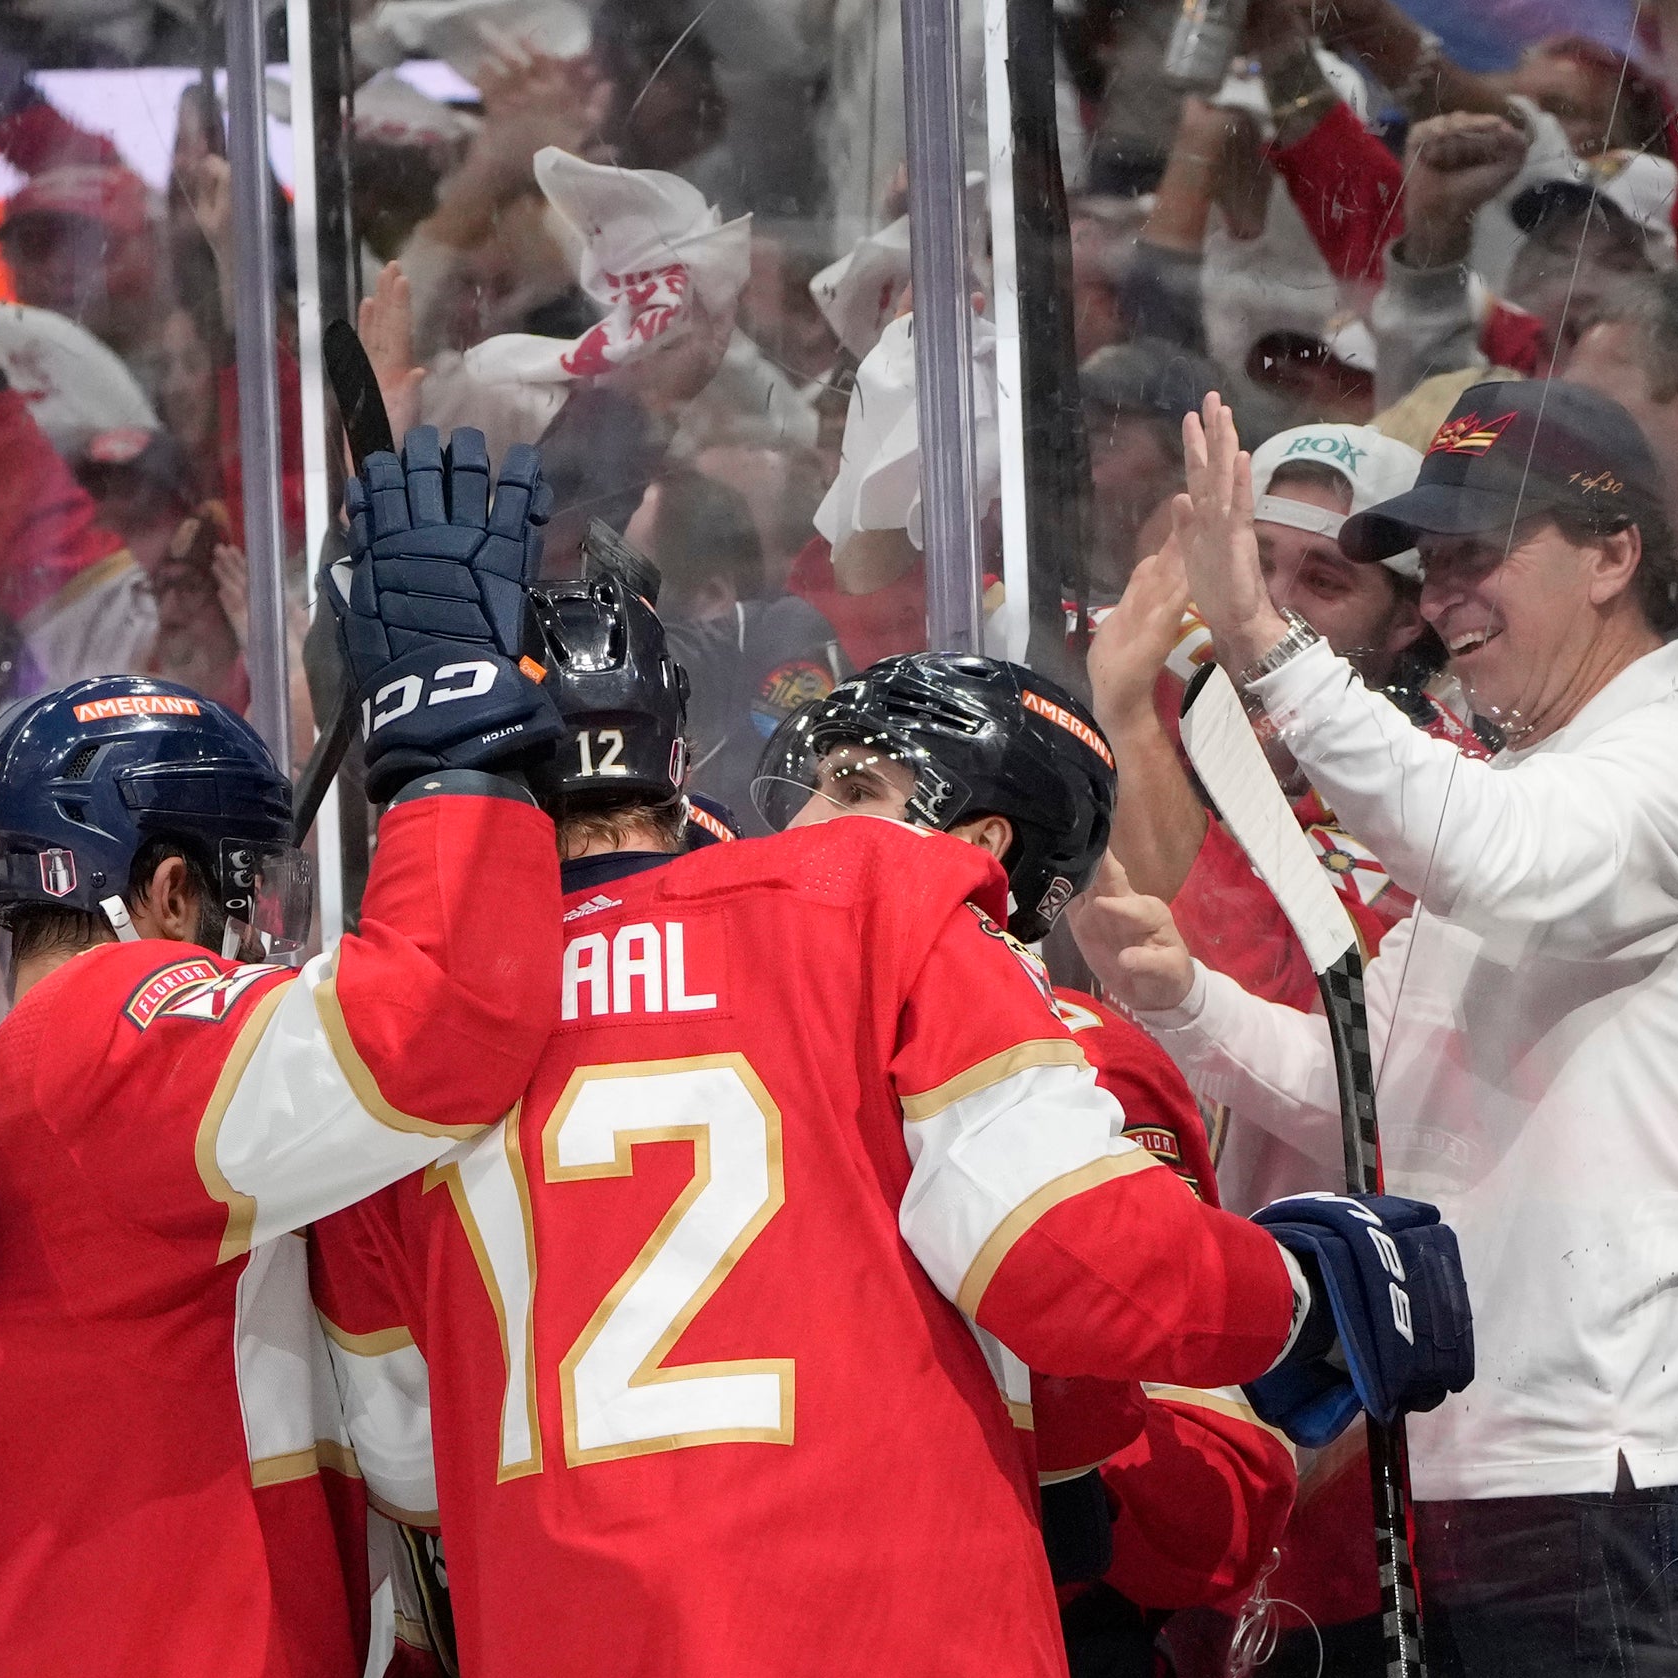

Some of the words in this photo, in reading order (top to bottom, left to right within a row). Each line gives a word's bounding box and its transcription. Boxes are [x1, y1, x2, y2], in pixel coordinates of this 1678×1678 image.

[78, 699, 198, 721] AMERANT
[482, 724, 524, 744] BUTCH
[1024, 694, 1113, 768] AMERANT
[575, 729, 626, 777] 12
[139, 966, 208, 1015] FLORIDA
[422, 1052, 796, 1485] 12
